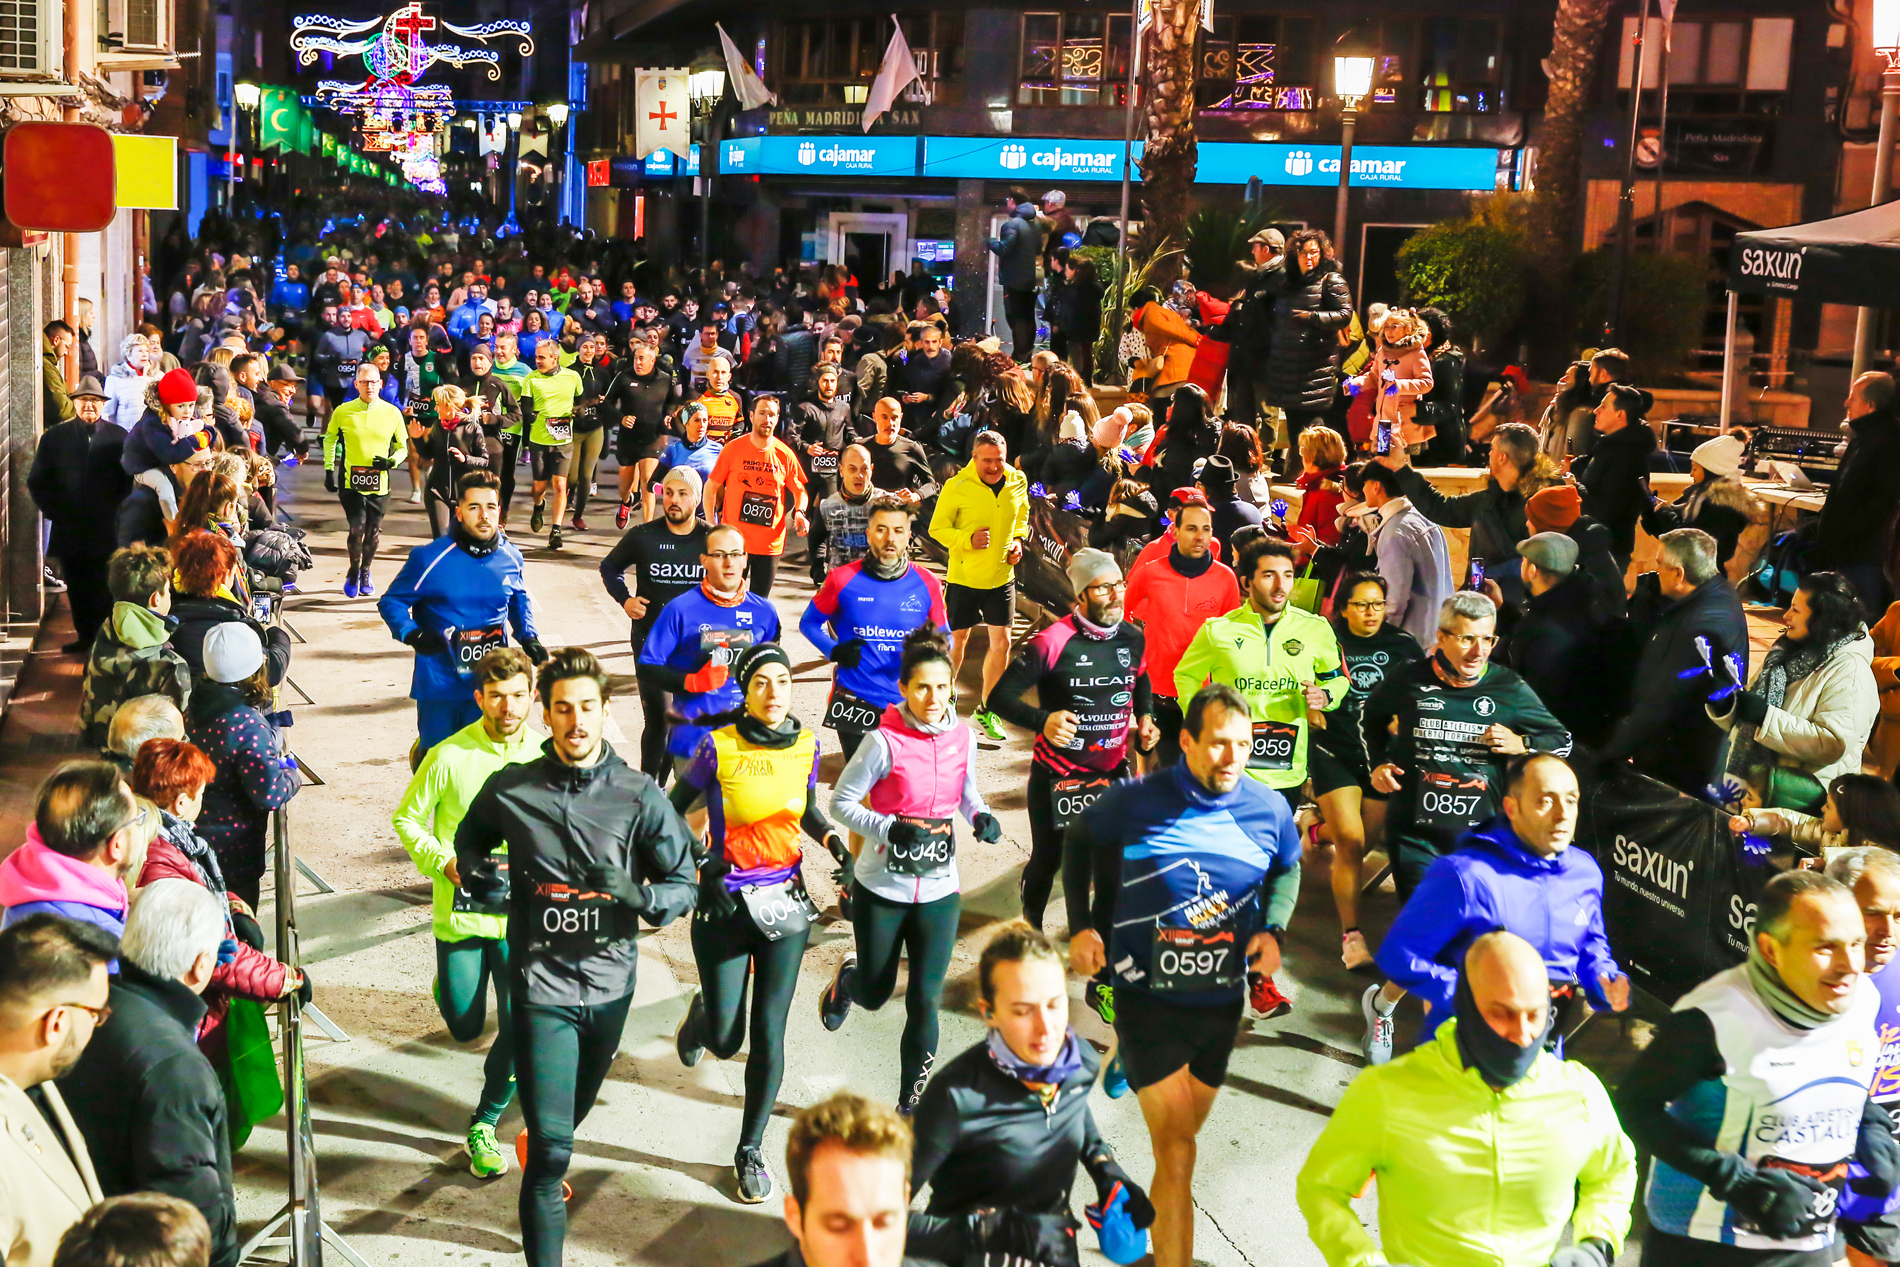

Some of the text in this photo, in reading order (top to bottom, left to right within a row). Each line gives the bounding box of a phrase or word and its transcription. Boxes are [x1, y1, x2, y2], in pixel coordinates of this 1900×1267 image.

[769, 107, 921, 125] PEÑA MADRIDIA SAX
[1685, 132, 1763, 143] Peña Madridista
[819, 143, 876, 167] cajamar
[1031, 147, 1117, 171] cajamar
[646, 162, 672, 171] cajamar
[1091, 166, 1114, 174] RURAL
[1318, 157, 1407, 174] caamar
[1359, 173, 1378, 181] CAJA
[1740, 247, 1807, 280] saxun
[337, 364, 356, 372] 0954
[408, 400, 429, 411] 0070
[548, 425, 570, 435] 0993
[813, 456, 837, 467] 0953
[351, 474, 379, 486] 0903
[742, 503, 773, 519] 0870
[649, 563, 707, 578] saxun
[877, 643, 896, 652] fibra
[1069, 675, 1135, 687] ILICAR
[831, 701, 876, 727] 0470
[1420, 718, 1441, 729] CLUB
[1250, 738, 1291, 757] 959
[1057, 793, 1102, 815] 059
[1423, 791, 1482, 815] 0857
[1613, 834, 1694, 900] saxun
[1639, 887, 1661, 904] nuestro
[758, 889, 808, 926] 0041
[543, 907, 600, 933] 0811
[1735, 940, 1751, 954] mun
[1160, 948, 1229, 976] 0597
